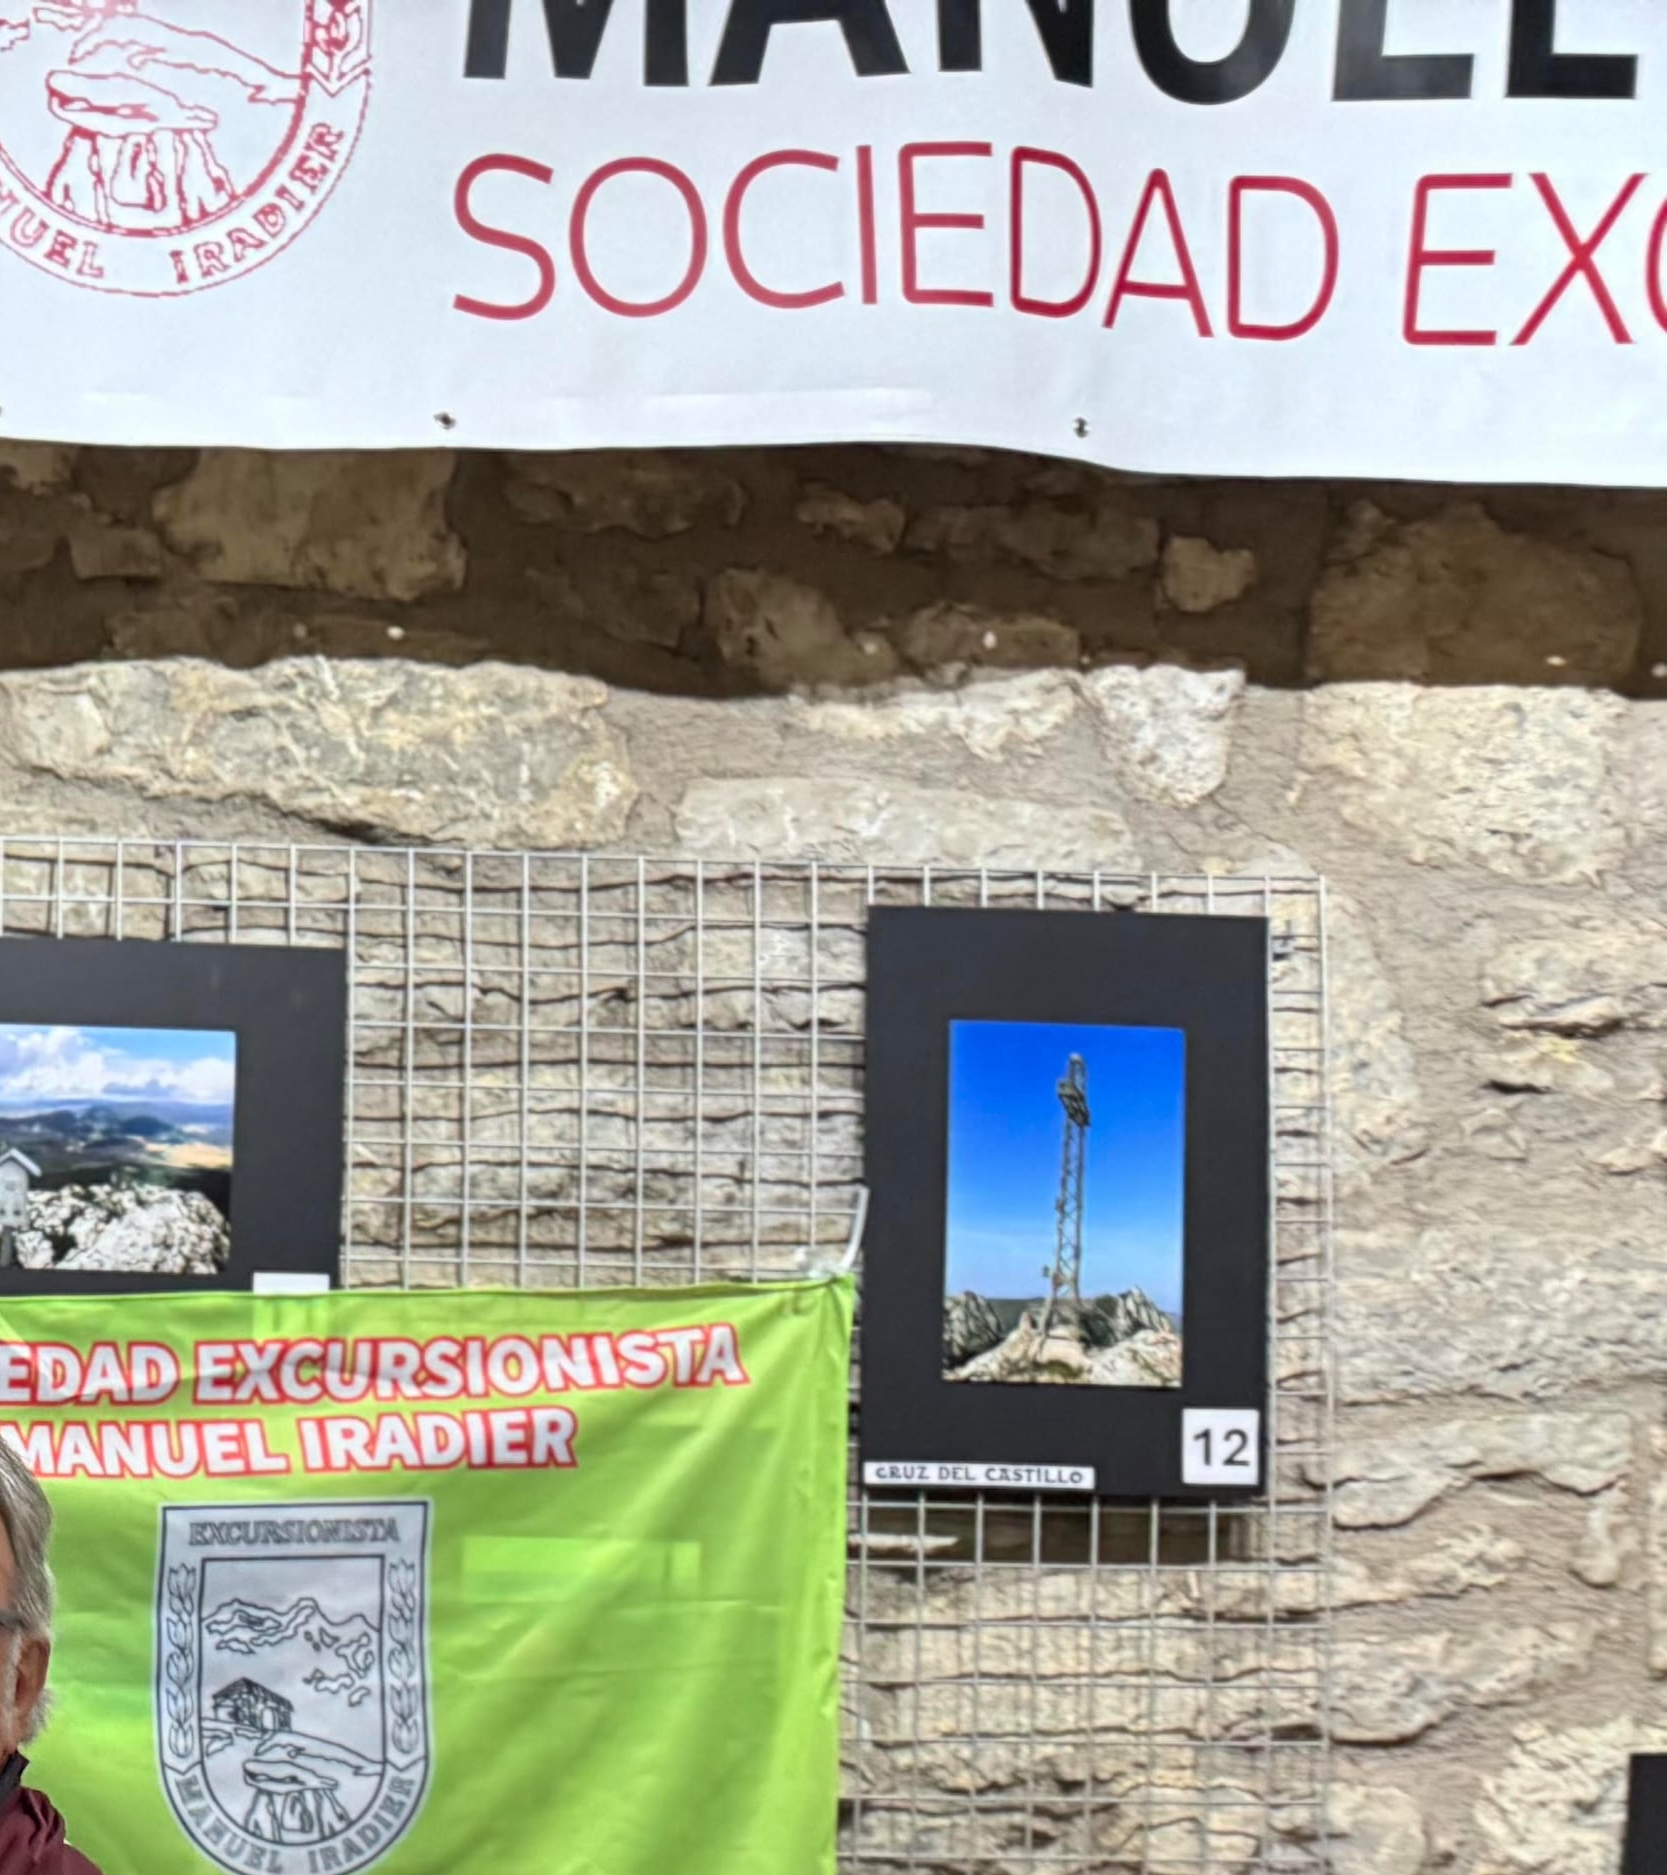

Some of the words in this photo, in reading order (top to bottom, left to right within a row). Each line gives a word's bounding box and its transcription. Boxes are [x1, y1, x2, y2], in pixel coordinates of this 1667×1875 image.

[172, 121, 345, 283] IRADIER
[453, 142, 1340, 339] SOCIEDAD
[1403, 172, 1667, 346] EX
[192, 1322, 751, 1406] EXCURSIONISTA
[299, 1405, 579, 1470] IRADIER
[1192, 1428, 1251, 1467] 12
[875, 1466, 932, 1482] CRUZ
[938, 1467, 978, 1482] DEL
[984, 1467, 1085, 1484] CASTILLO
[188, 1518, 401, 1547] EXCURSIONISTA
[175, 1773, 283, 1875] MANUEL
[307, 1774, 415, 1875] IRADIER
